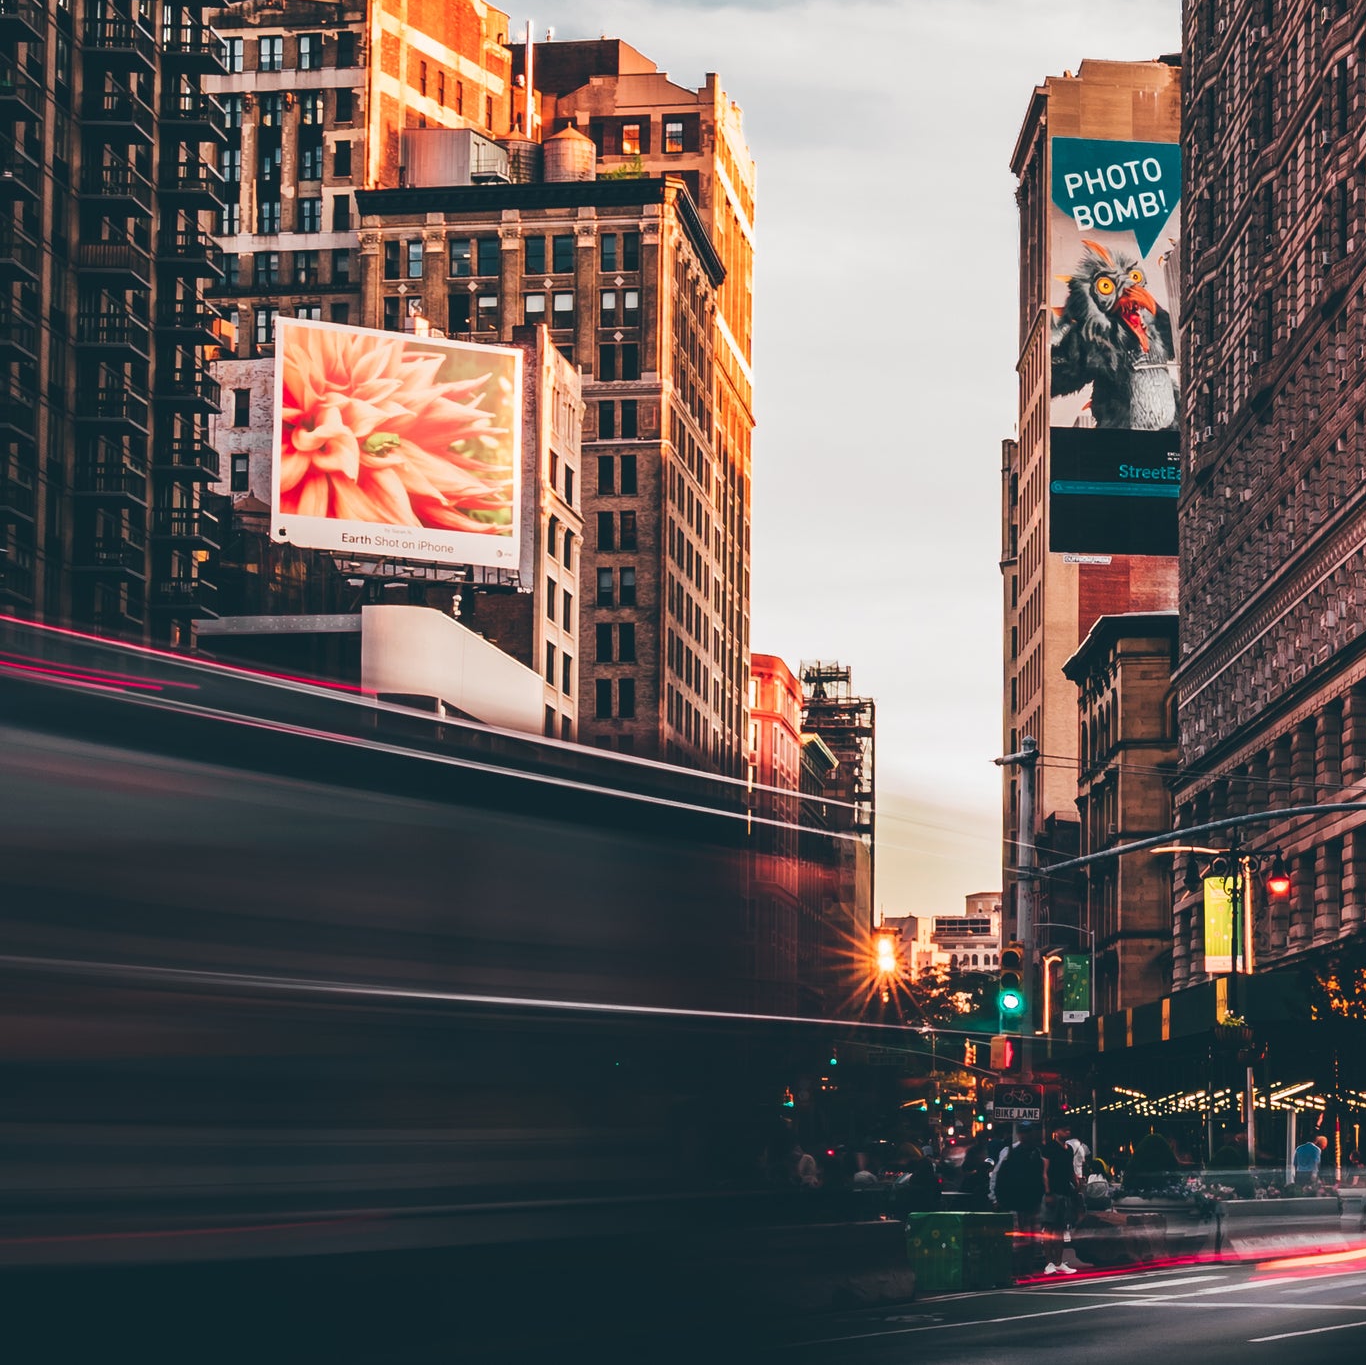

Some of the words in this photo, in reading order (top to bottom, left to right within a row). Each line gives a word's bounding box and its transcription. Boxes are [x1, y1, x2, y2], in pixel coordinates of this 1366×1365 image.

[1064, 157, 1162, 199] PHOTO
[1072, 189, 1168, 231] BOMB!
[341, 533, 372, 545] Earth
[375, 536, 400, 548] Shot
[402, 541, 415, 550] on
[418, 541, 454, 554] iPhone
[995, 1108, 1014, 1118] BIKE
[1017, 1109, 1039, 1119] LANE
